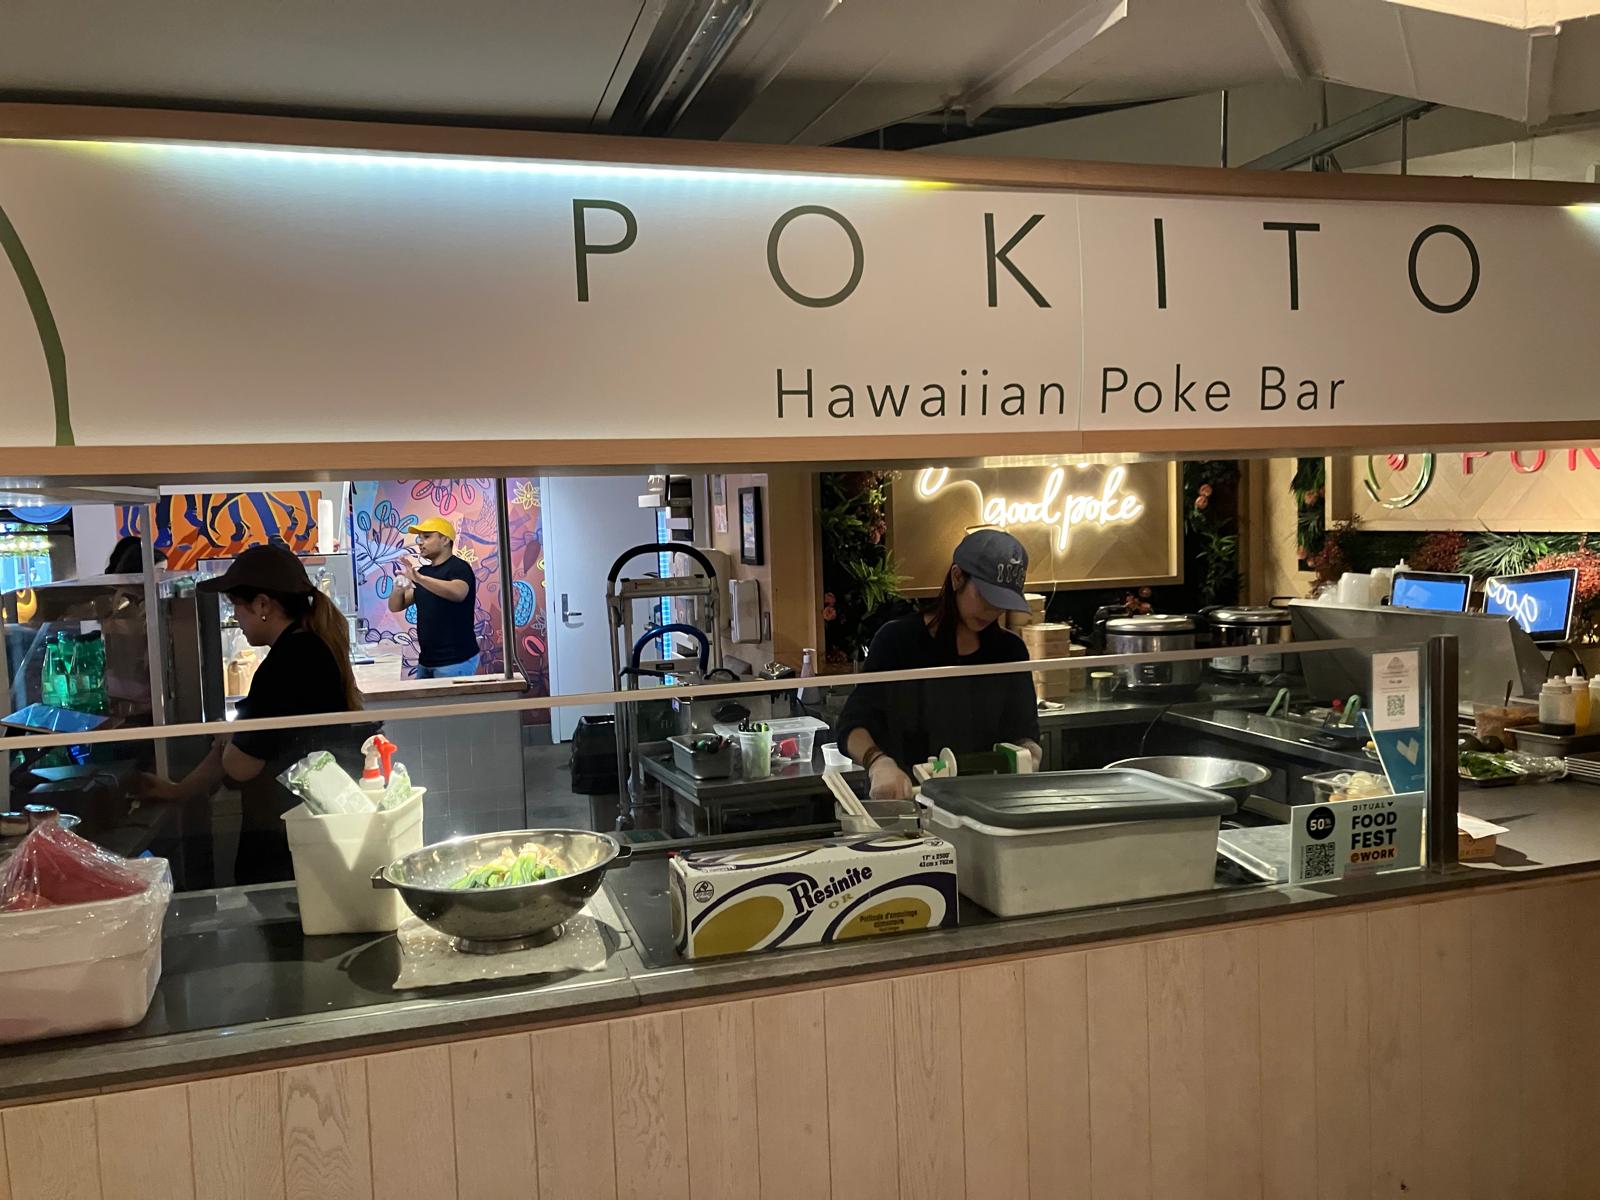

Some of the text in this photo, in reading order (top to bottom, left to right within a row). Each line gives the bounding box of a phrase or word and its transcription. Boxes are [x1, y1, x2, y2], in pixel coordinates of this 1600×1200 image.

[572, 198, 1481, 314] POKITO
[776, 363, 1345, 419] Hawaiian Poke Bar
[983, 467, 1061, 527] good
[1059, 465, 1143, 551] poke
[1352, 801, 1385, 812] RITUAL
[1352, 811, 1397, 830] FOOD
[1350, 848, 1395, 864] @WORK
[1351, 828, 1397, 850] FEST
[786, 866, 873, 916] Resinite
